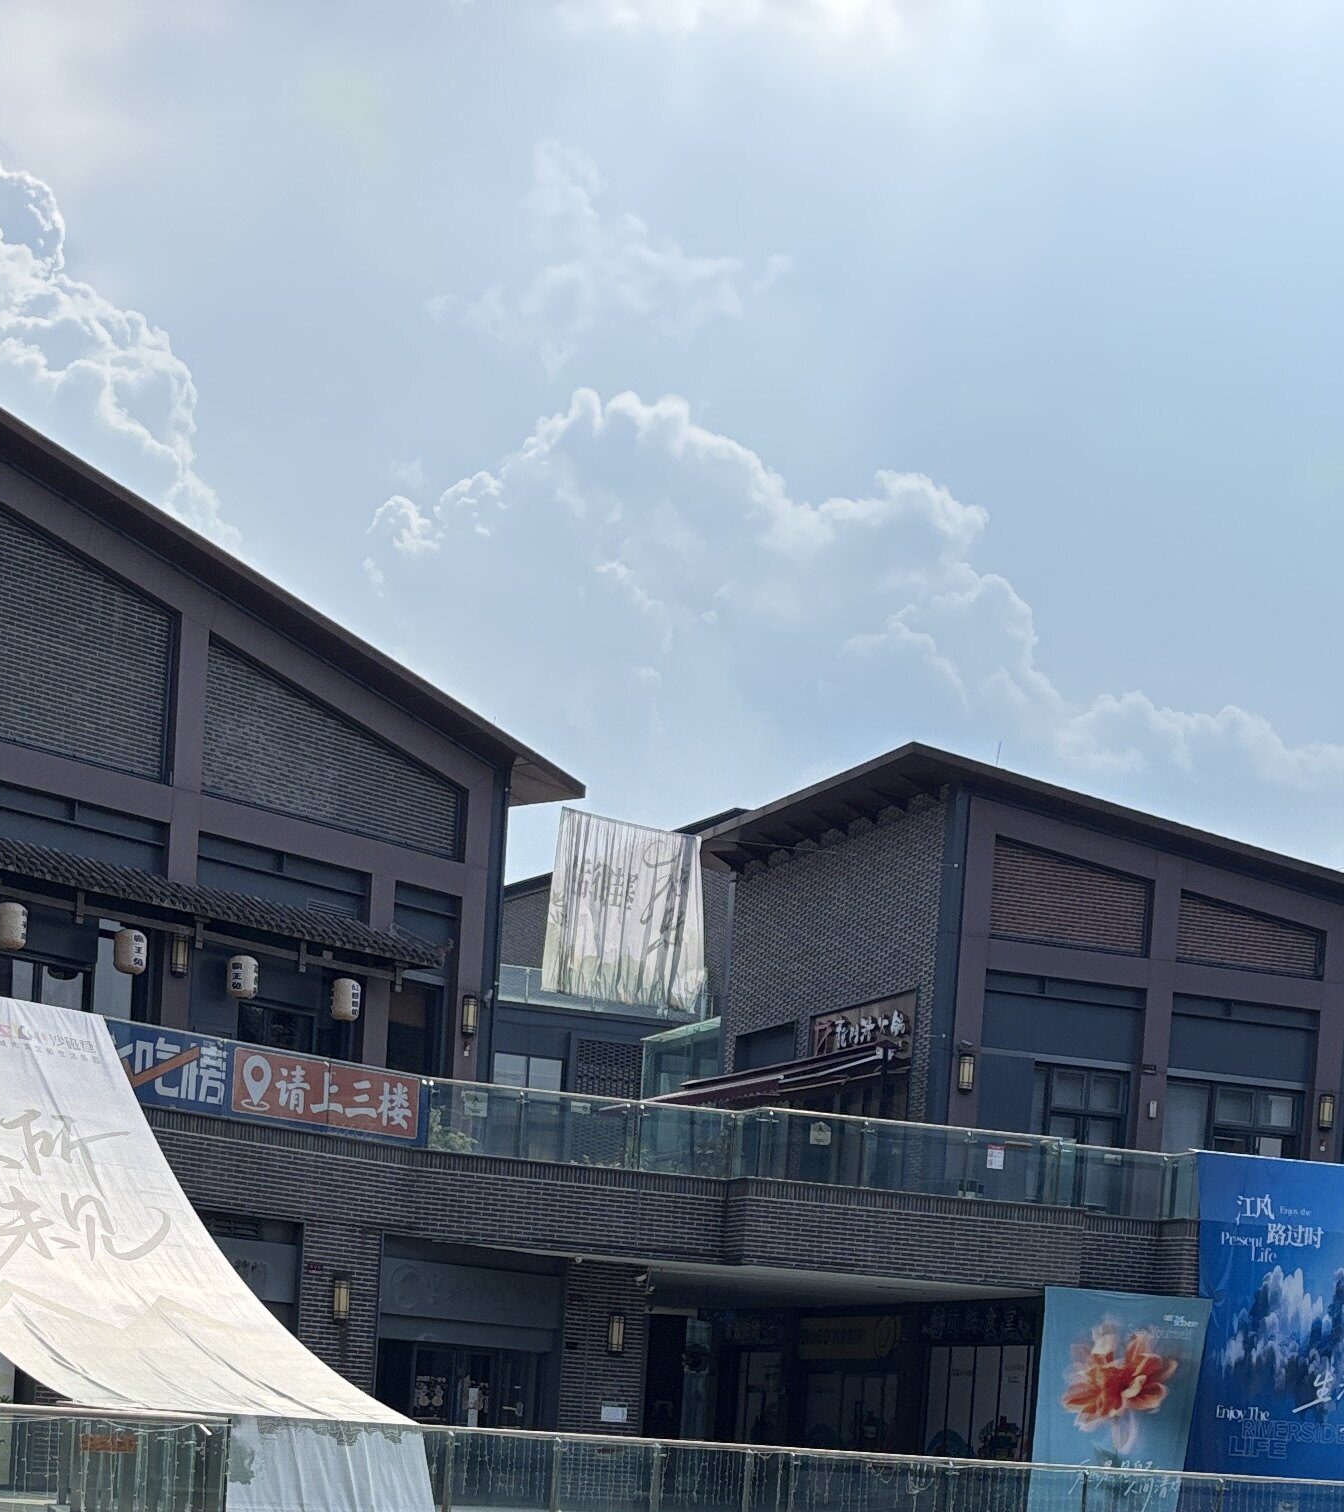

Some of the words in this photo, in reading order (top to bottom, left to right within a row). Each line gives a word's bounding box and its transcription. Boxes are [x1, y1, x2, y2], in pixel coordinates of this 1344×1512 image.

[276, 1064, 412, 1130] 请上三楼
[1237, 1194, 1275, 1225] 江风
[1267, 1223, 1324, 1249] 路过时
[1216, 1404, 1245, 1422] Enjoy
[1248, 1405, 1271, 1422] The
[1228, 1435, 1288, 1460] LIFE
